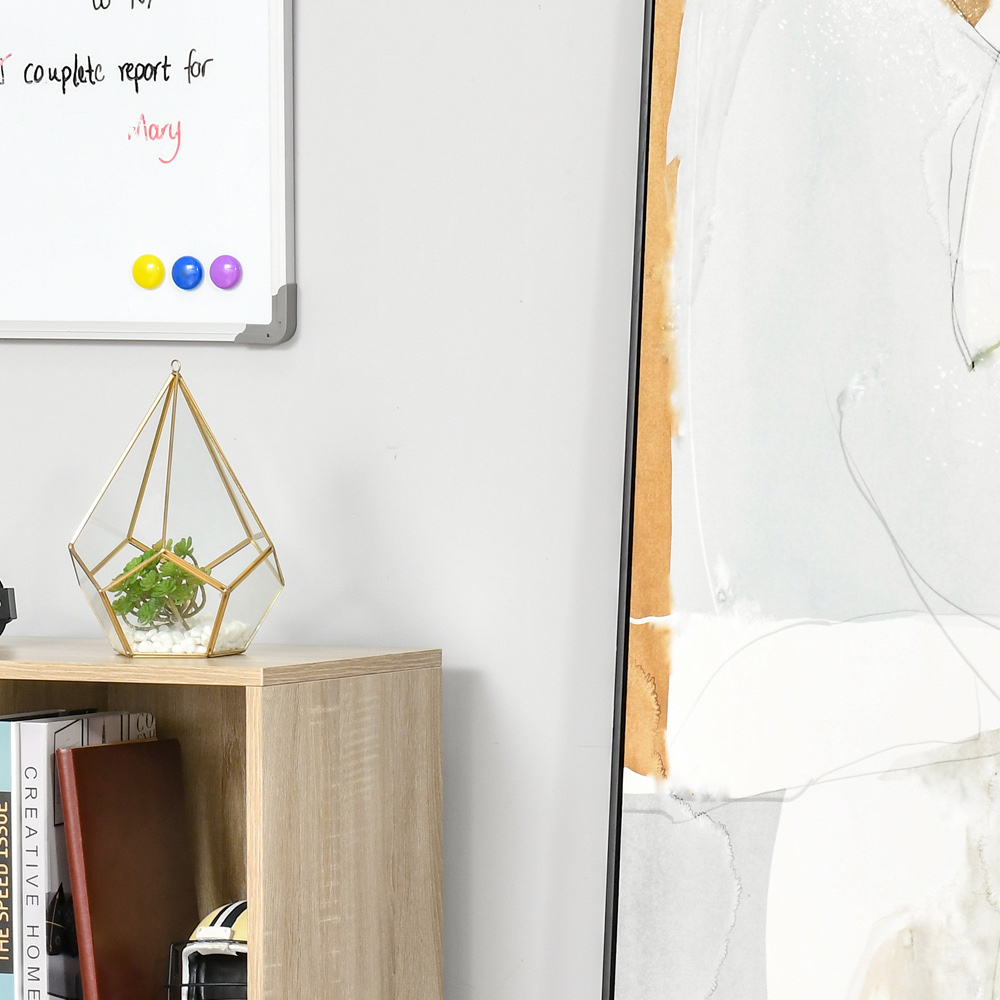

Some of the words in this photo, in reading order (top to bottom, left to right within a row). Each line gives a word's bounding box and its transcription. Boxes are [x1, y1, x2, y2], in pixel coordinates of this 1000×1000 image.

[118, 55, 172, 94] report
[184, 48, 214, 84] for
[24, 766, 40, 907] CREATIVE
